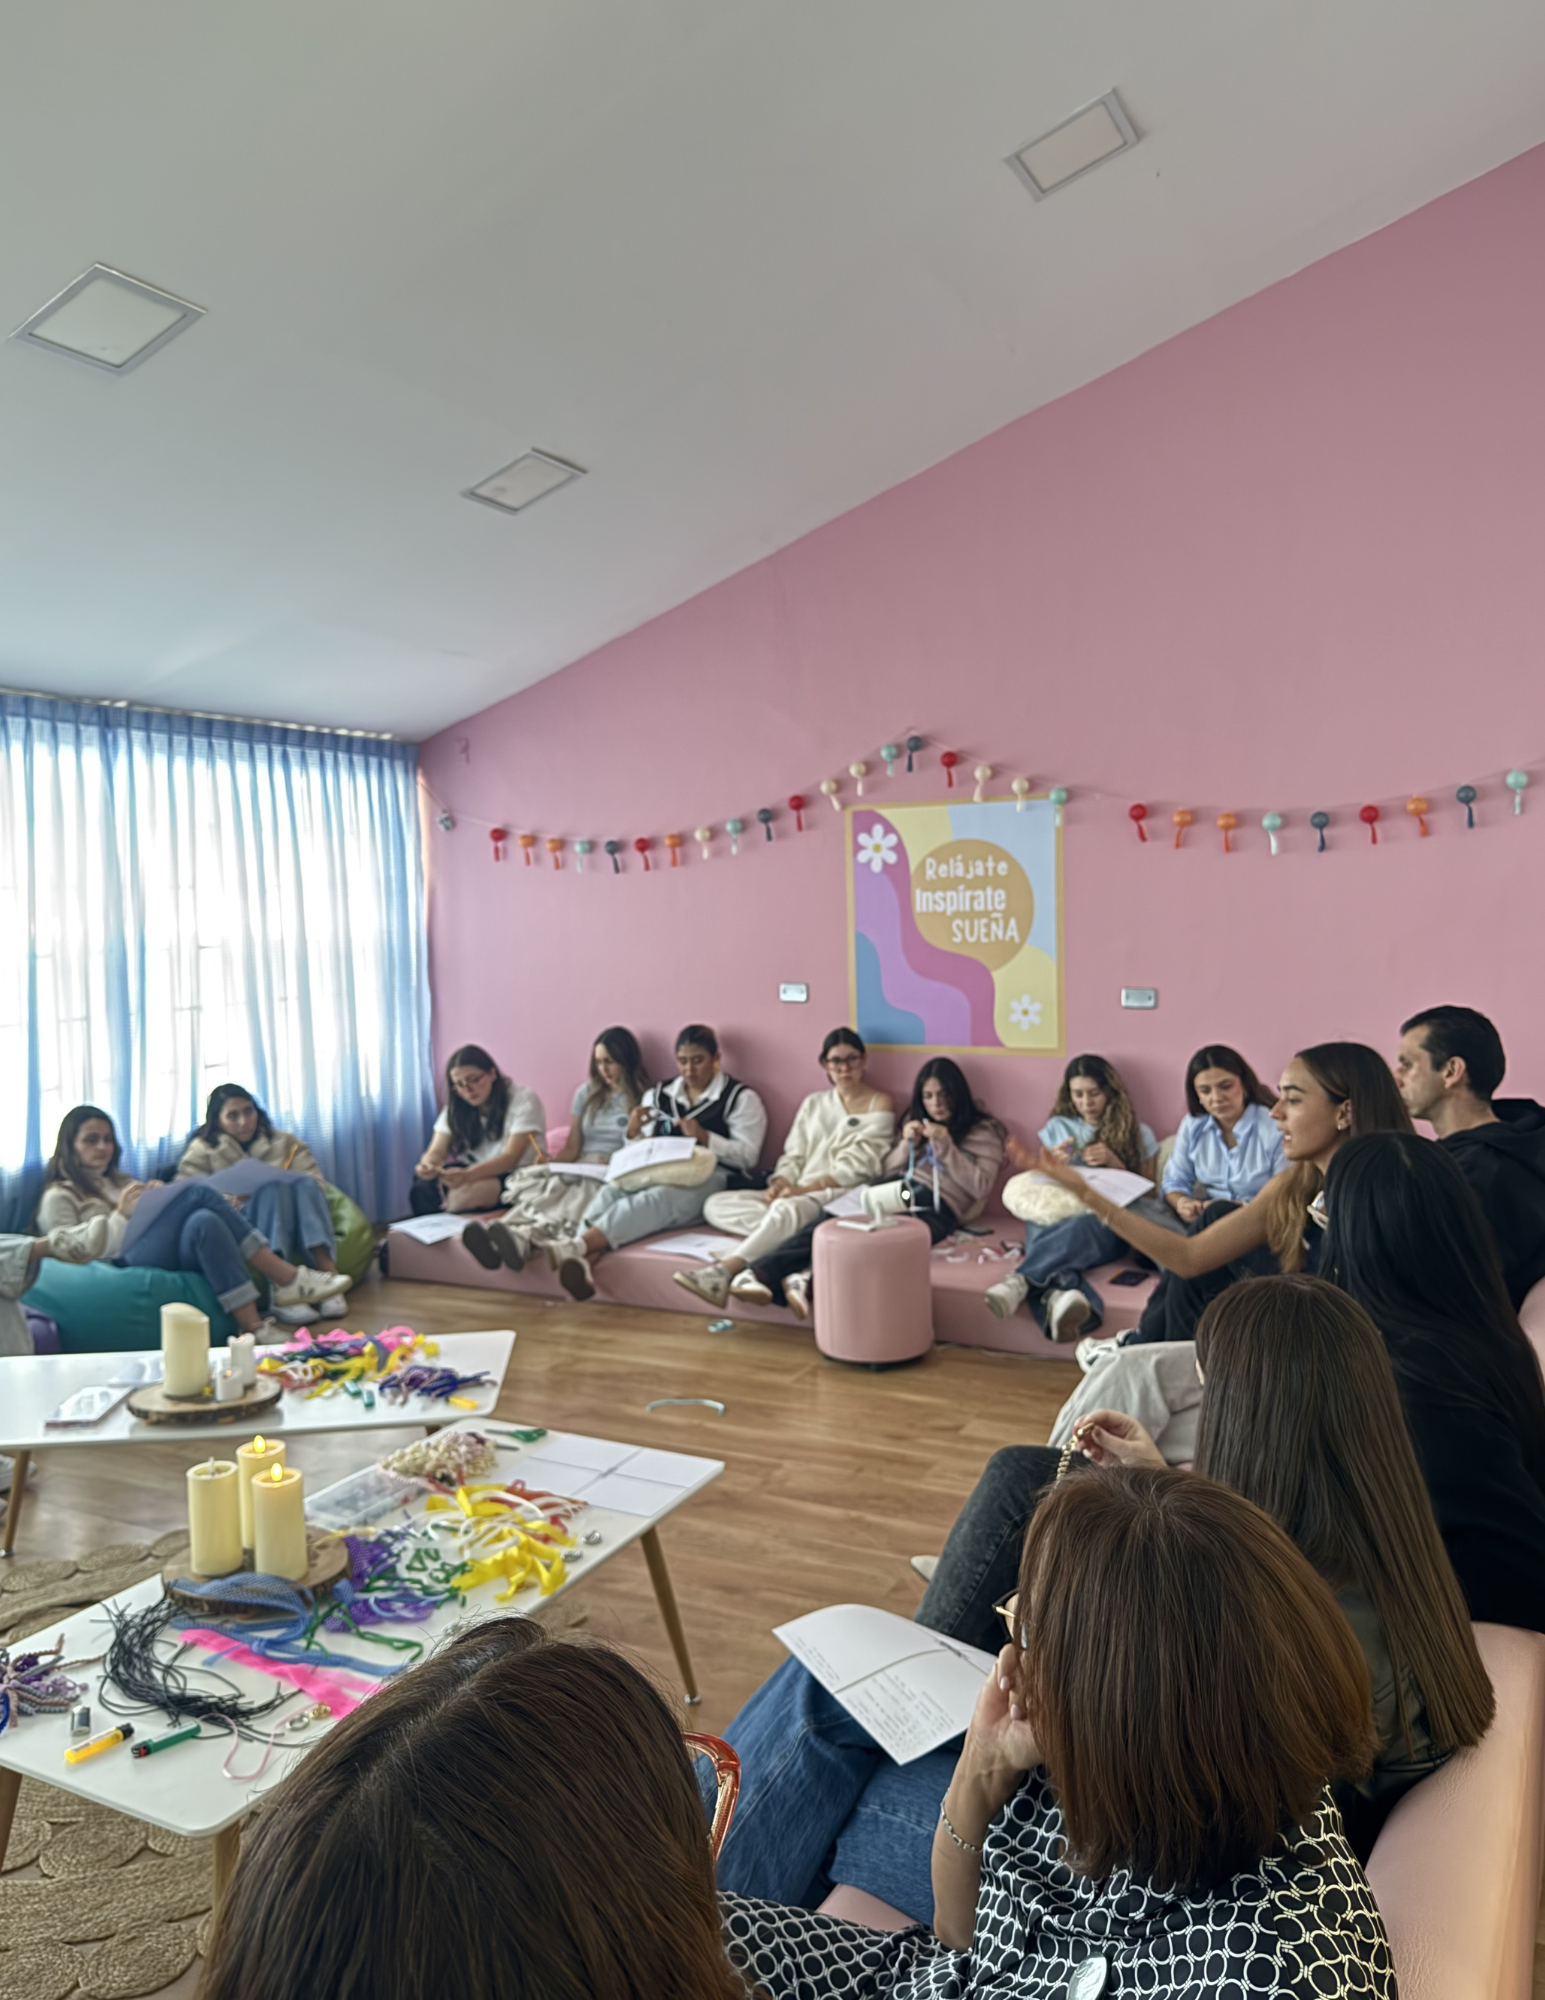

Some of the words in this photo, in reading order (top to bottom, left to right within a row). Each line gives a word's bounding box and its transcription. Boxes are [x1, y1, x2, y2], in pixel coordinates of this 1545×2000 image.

[925, 854, 1008, 881] Relájate
[915, 884, 1007, 916] Inspírate
[951, 912, 1020, 944] SUEÑA
